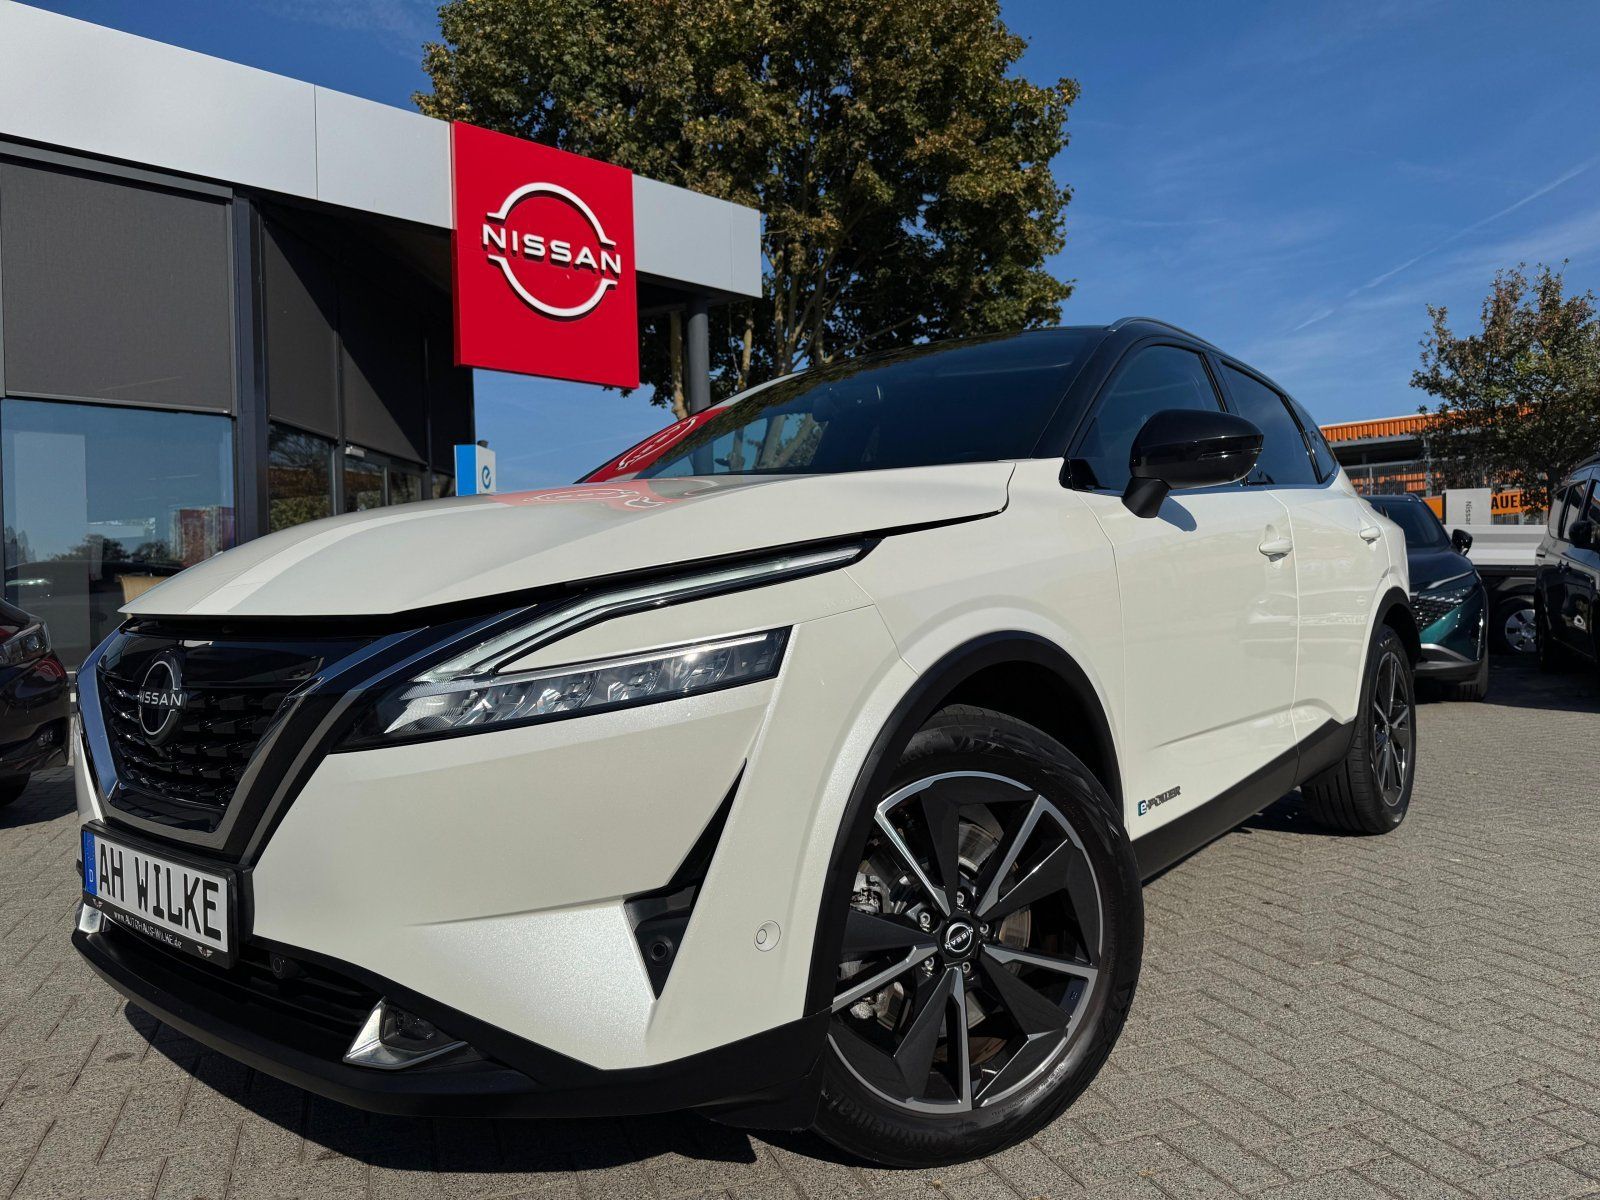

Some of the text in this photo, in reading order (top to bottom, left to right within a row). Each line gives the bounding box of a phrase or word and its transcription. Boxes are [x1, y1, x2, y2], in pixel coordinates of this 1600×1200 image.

[482, 223, 622, 275] NISSAN
[139, 691, 182, 706] NISSAN
[99, 843, 222, 942] AH WILKE
[944, 927, 974, 949] NISSAN
